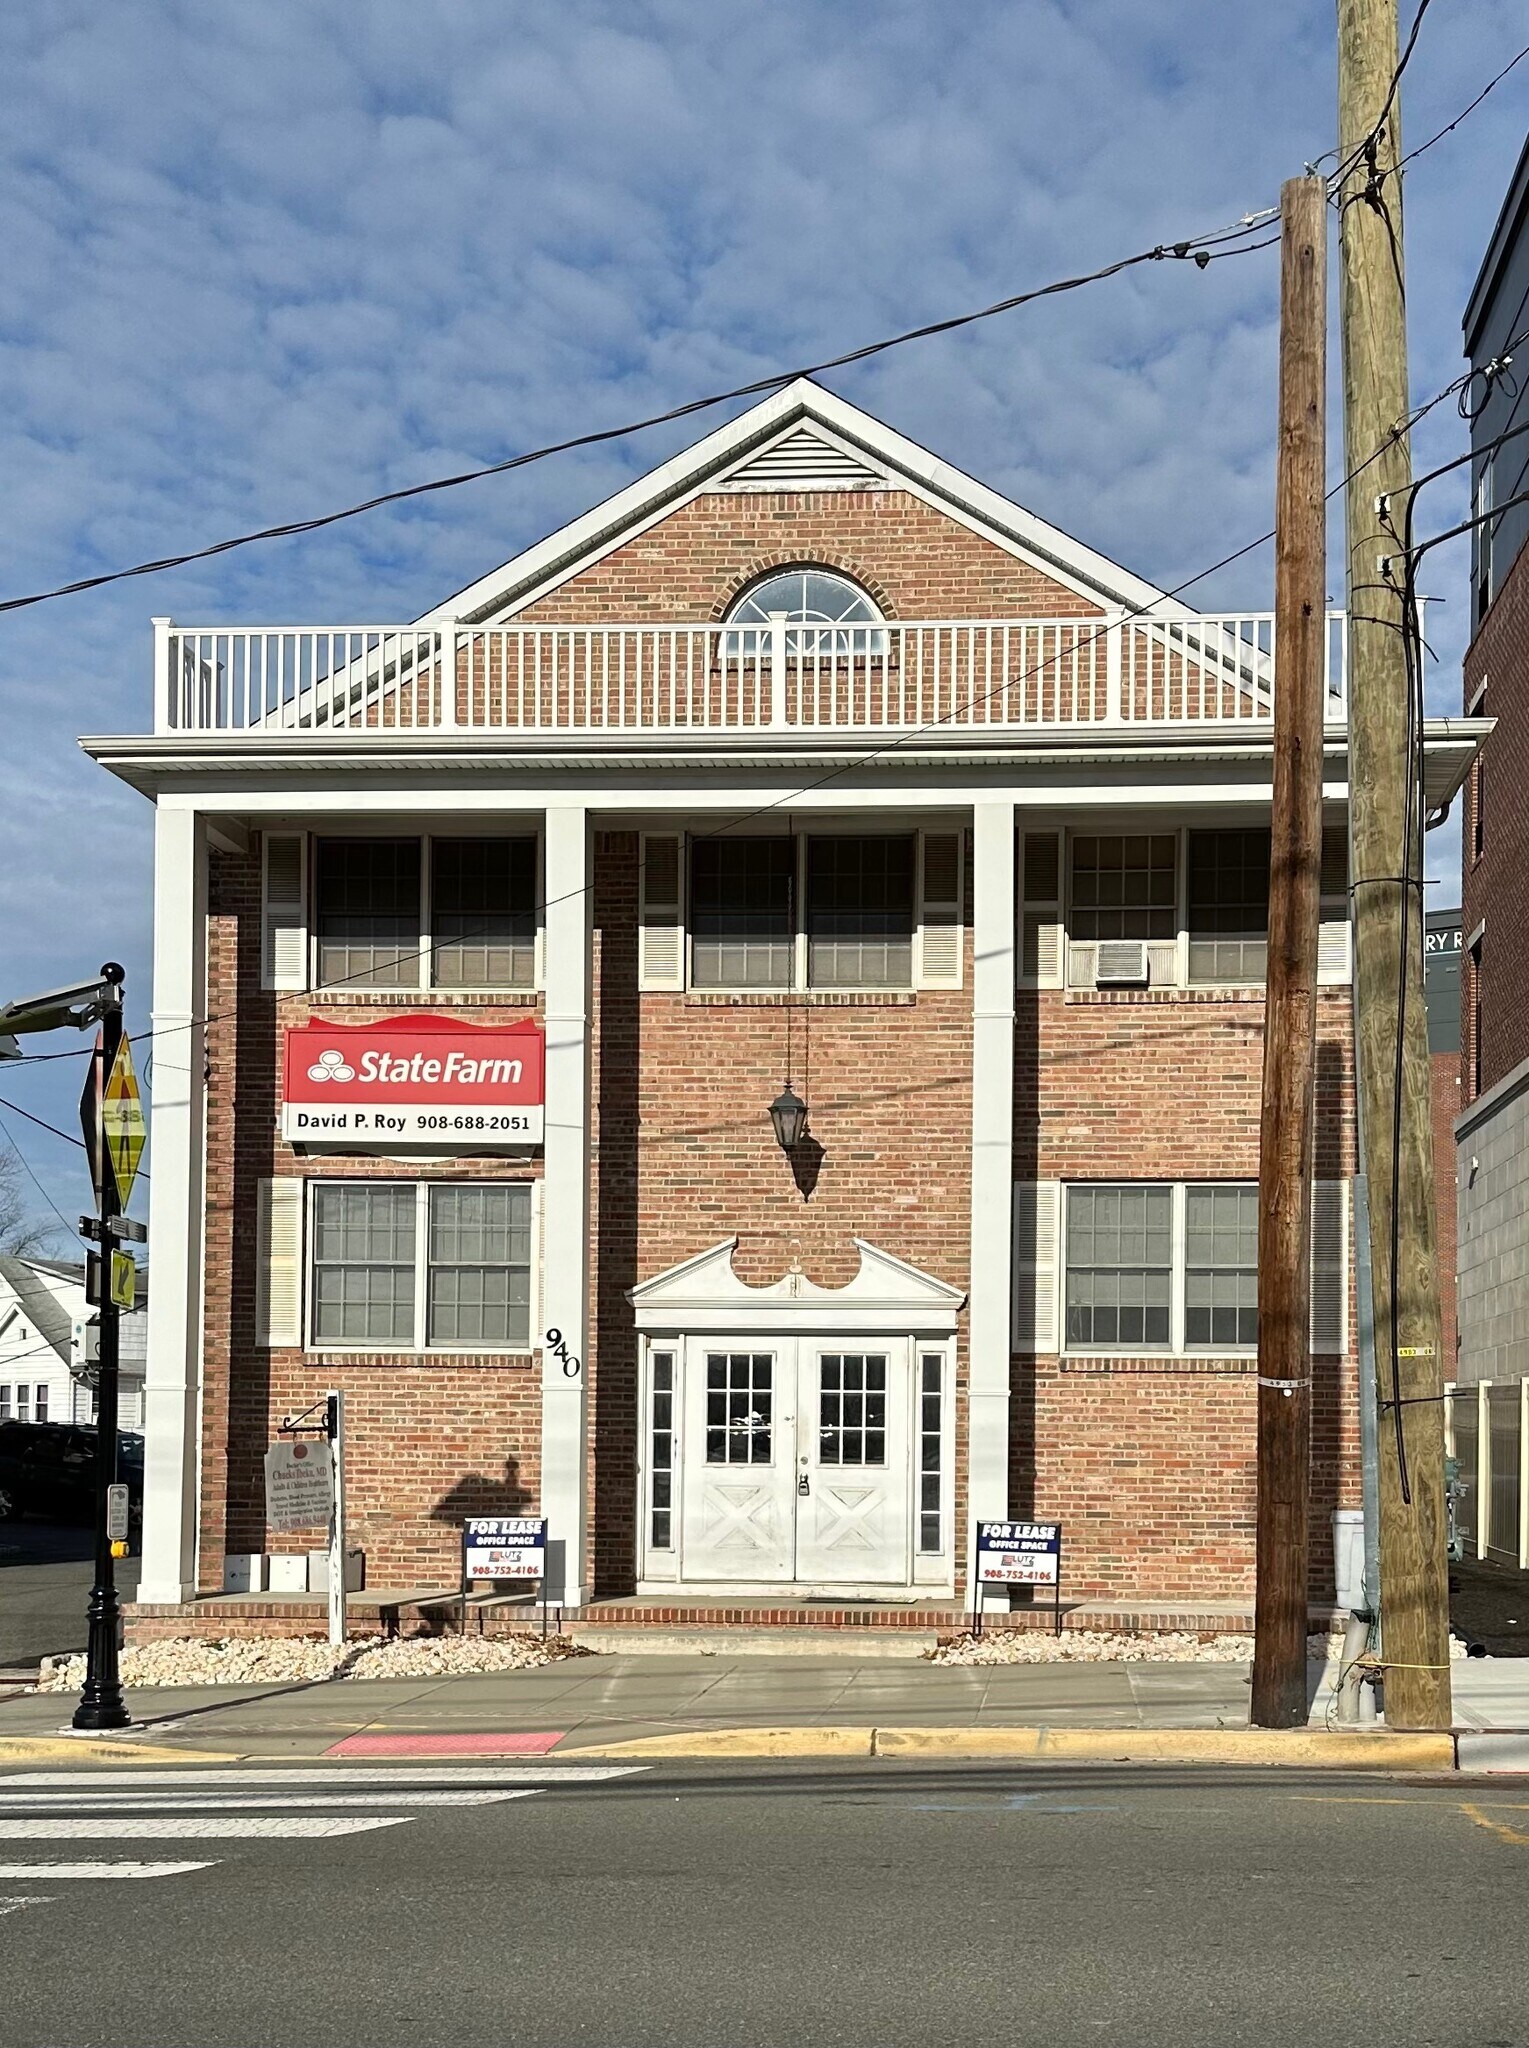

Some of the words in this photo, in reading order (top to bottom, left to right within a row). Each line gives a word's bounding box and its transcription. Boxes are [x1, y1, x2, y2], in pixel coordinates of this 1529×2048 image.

[297, 1113, 347, 1129] David
[354, 1114, 369, 1129] P.
[374, 1114, 407, 1132] Roy
[417, 1116, 530, 1131] 908-688-2051
[546, 1328, 580, 1377] 940
[469, 1521, 499, 1535] FOR
[501, 1521, 543, 1535] LEASE
[981, 1524, 1012, 1538] FOR
[1014, 1525, 1056, 1540] LEASE
[476, 1536, 506, 1545] OFFICE
[507, 1536, 535, 1545] SPACE
[988, 1540, 1020, 1549] OFFICE
[1020, 1541, 1049, 1551] SPACE
[472, 1566, 539, 1575] 908-752-4106
[984, 1569, 1052, 1581] 908-752-4106
